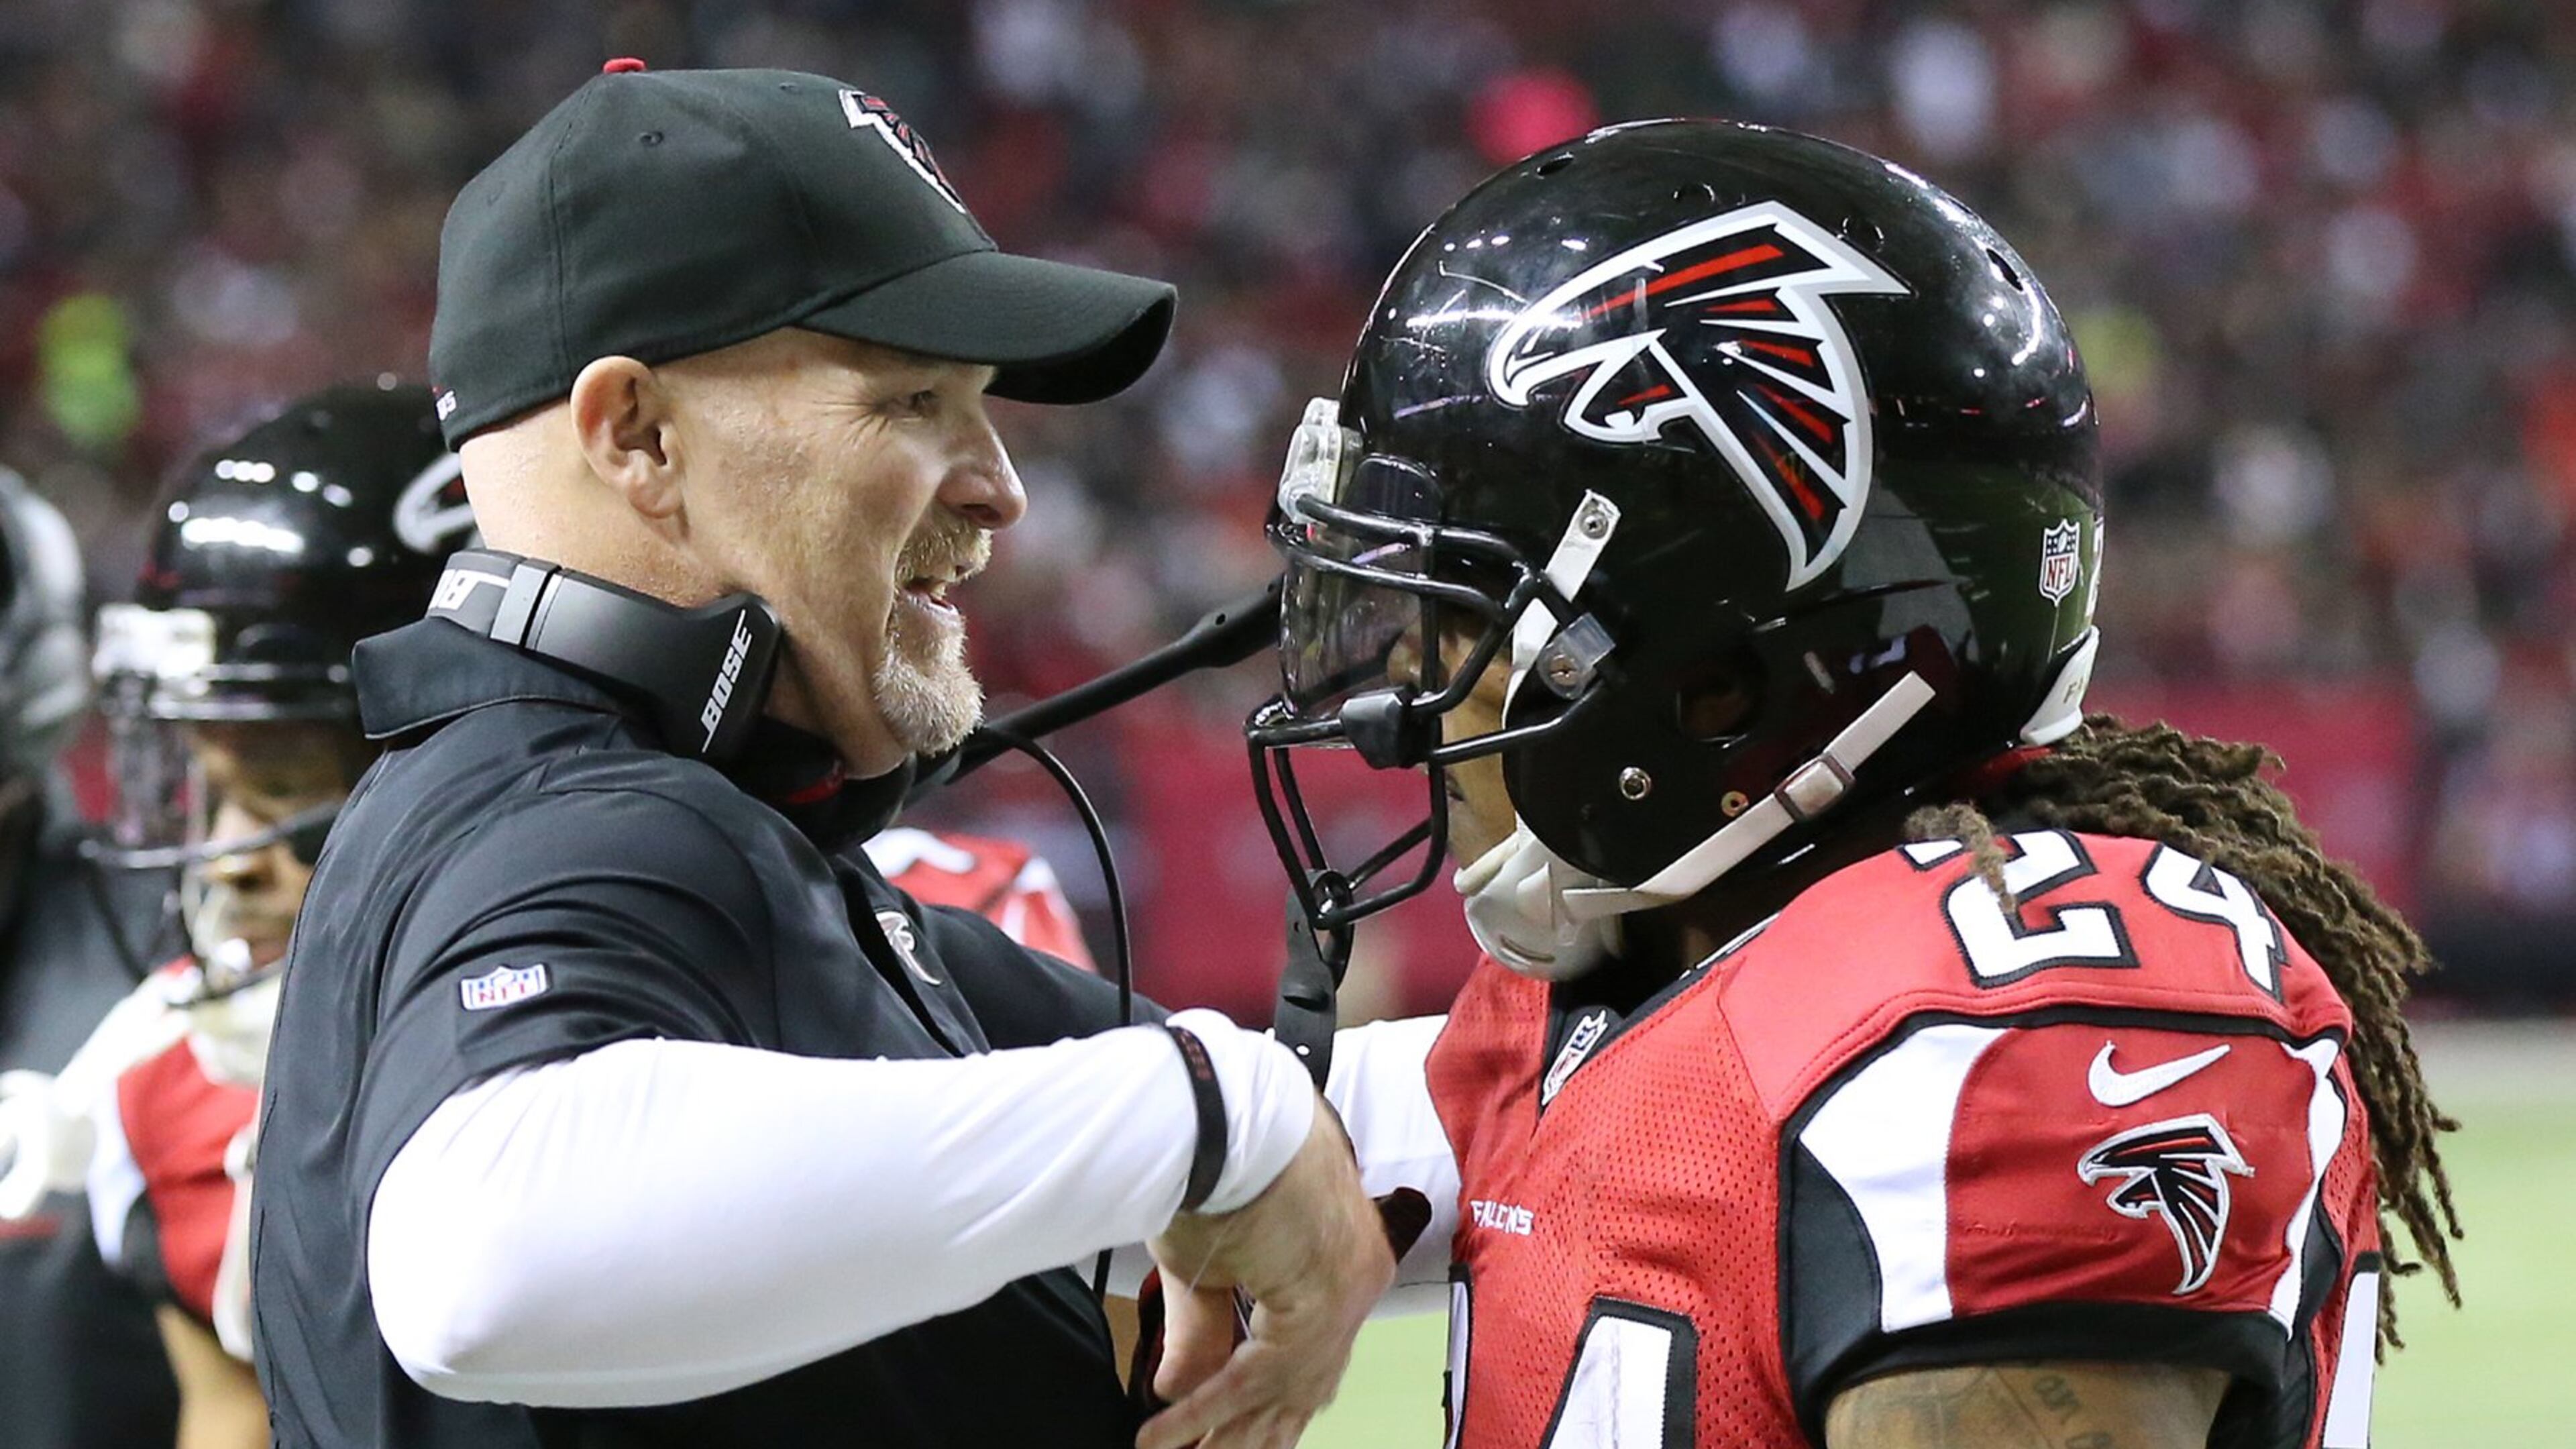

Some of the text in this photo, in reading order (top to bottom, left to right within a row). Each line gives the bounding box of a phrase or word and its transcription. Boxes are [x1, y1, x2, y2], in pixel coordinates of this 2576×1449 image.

[2045, 555, 2073, 590] NFL
[700, 609, 752, 753] BOSE
[1897, 830, 2289, 1006] 24
